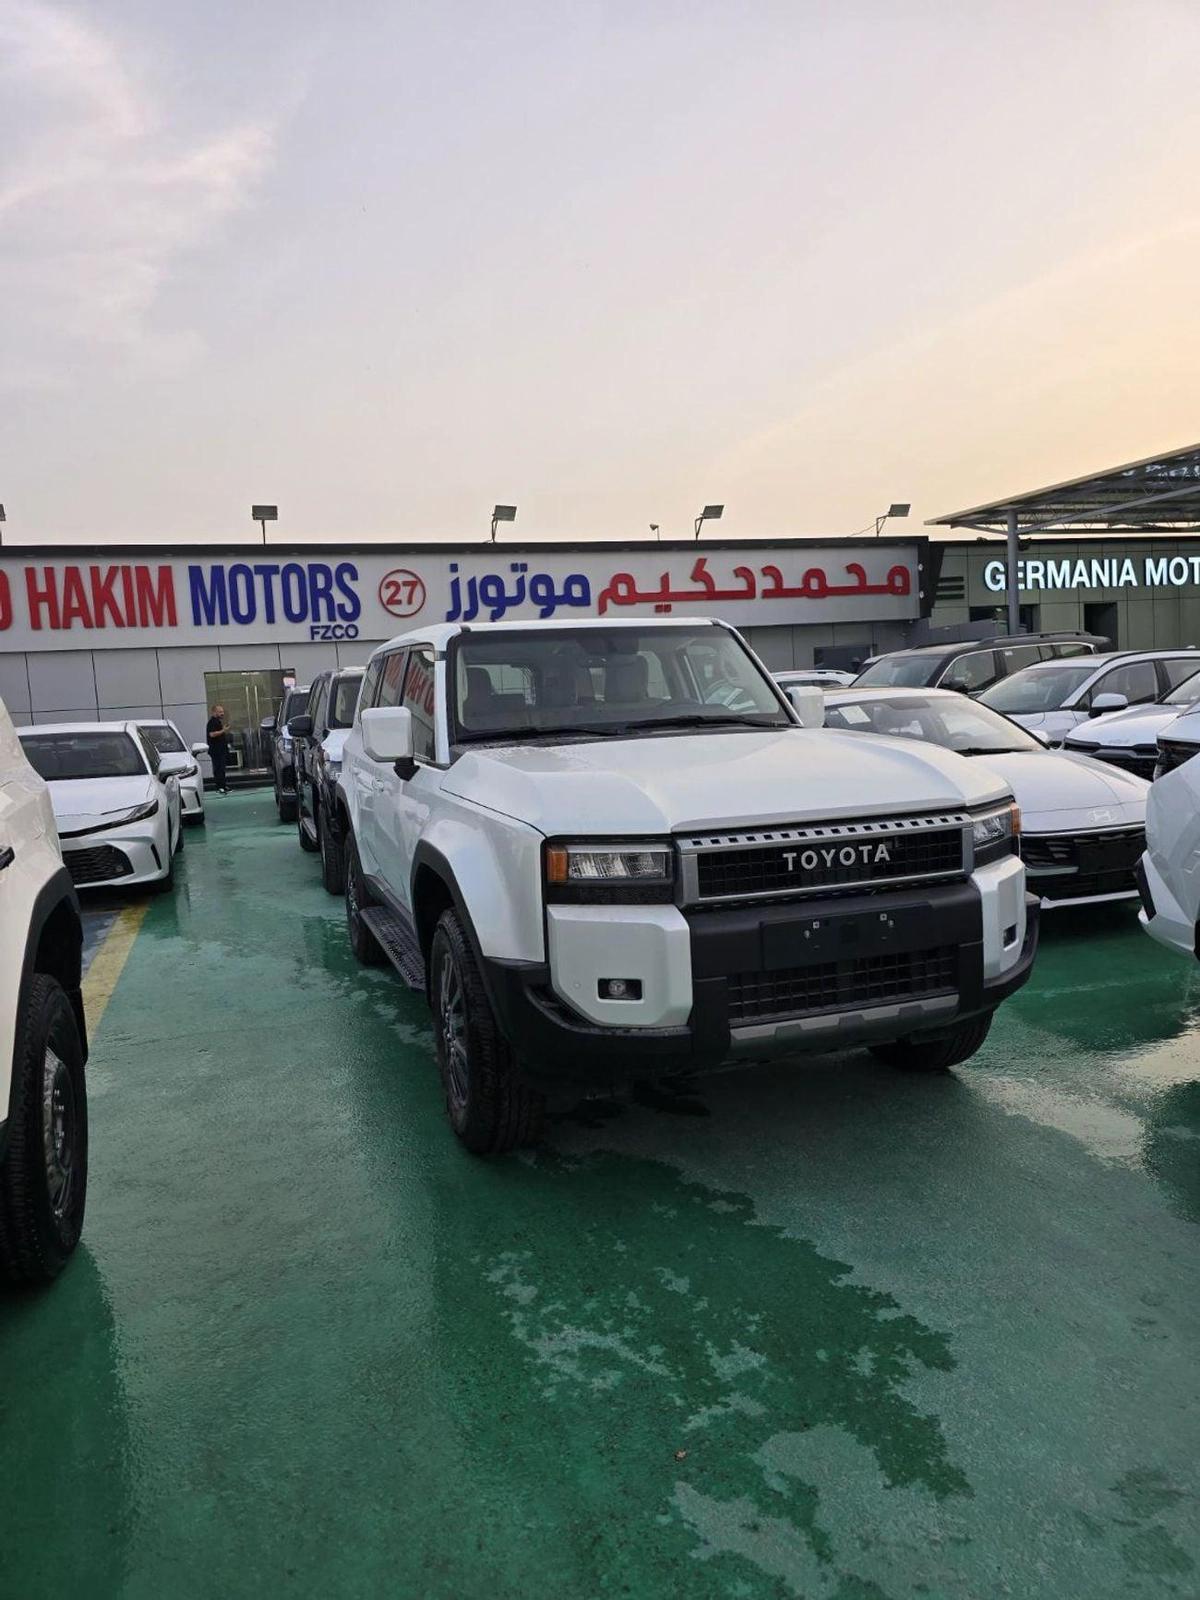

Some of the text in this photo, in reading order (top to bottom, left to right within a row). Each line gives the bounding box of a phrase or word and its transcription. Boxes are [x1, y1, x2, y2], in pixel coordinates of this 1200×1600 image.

[1145, 557, 1200, 587] MOT
[25, 565, 178, 630] HAKIM
[188, 562, 361, 627] MOTORS
[385, 580, 418, 605] 27
[446, 563, 591, 622] موتورز
[310, 624, 359, 641] FZCO
[782, 844, 890, 871] TOYOTA
